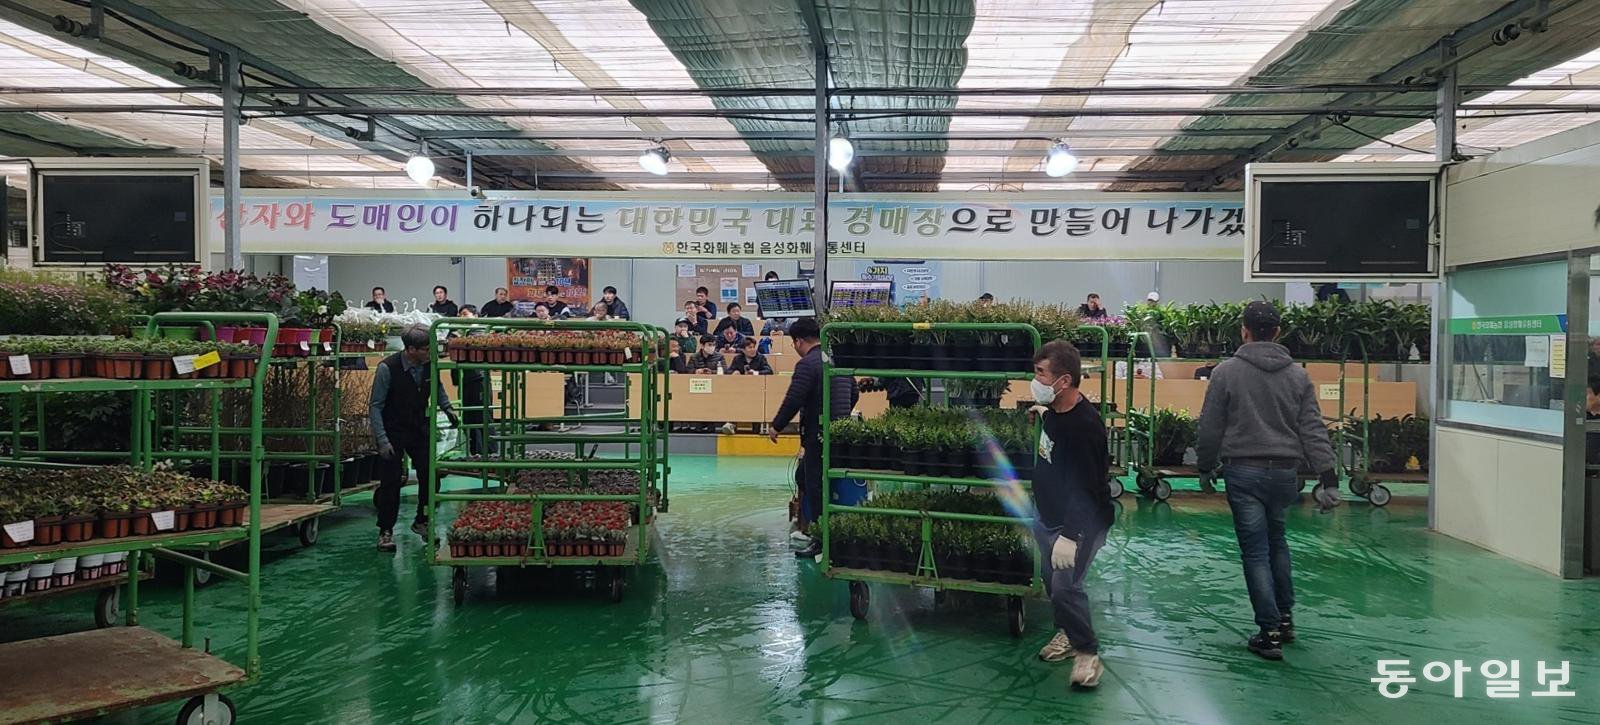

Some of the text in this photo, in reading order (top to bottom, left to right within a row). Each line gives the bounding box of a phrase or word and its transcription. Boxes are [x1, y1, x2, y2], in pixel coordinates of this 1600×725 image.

[325, 203, 458, 232] 도매인이
[473, 204, 606, 234] 하나되는
[617, 206, 752, 236] 대한민국
[843, 206, 1017, 236] 경매장으로
[1030, 206, 1131, 237] 만들어
[676, 241, 866, 255] 한국화훼농협 음성화훼통센터
